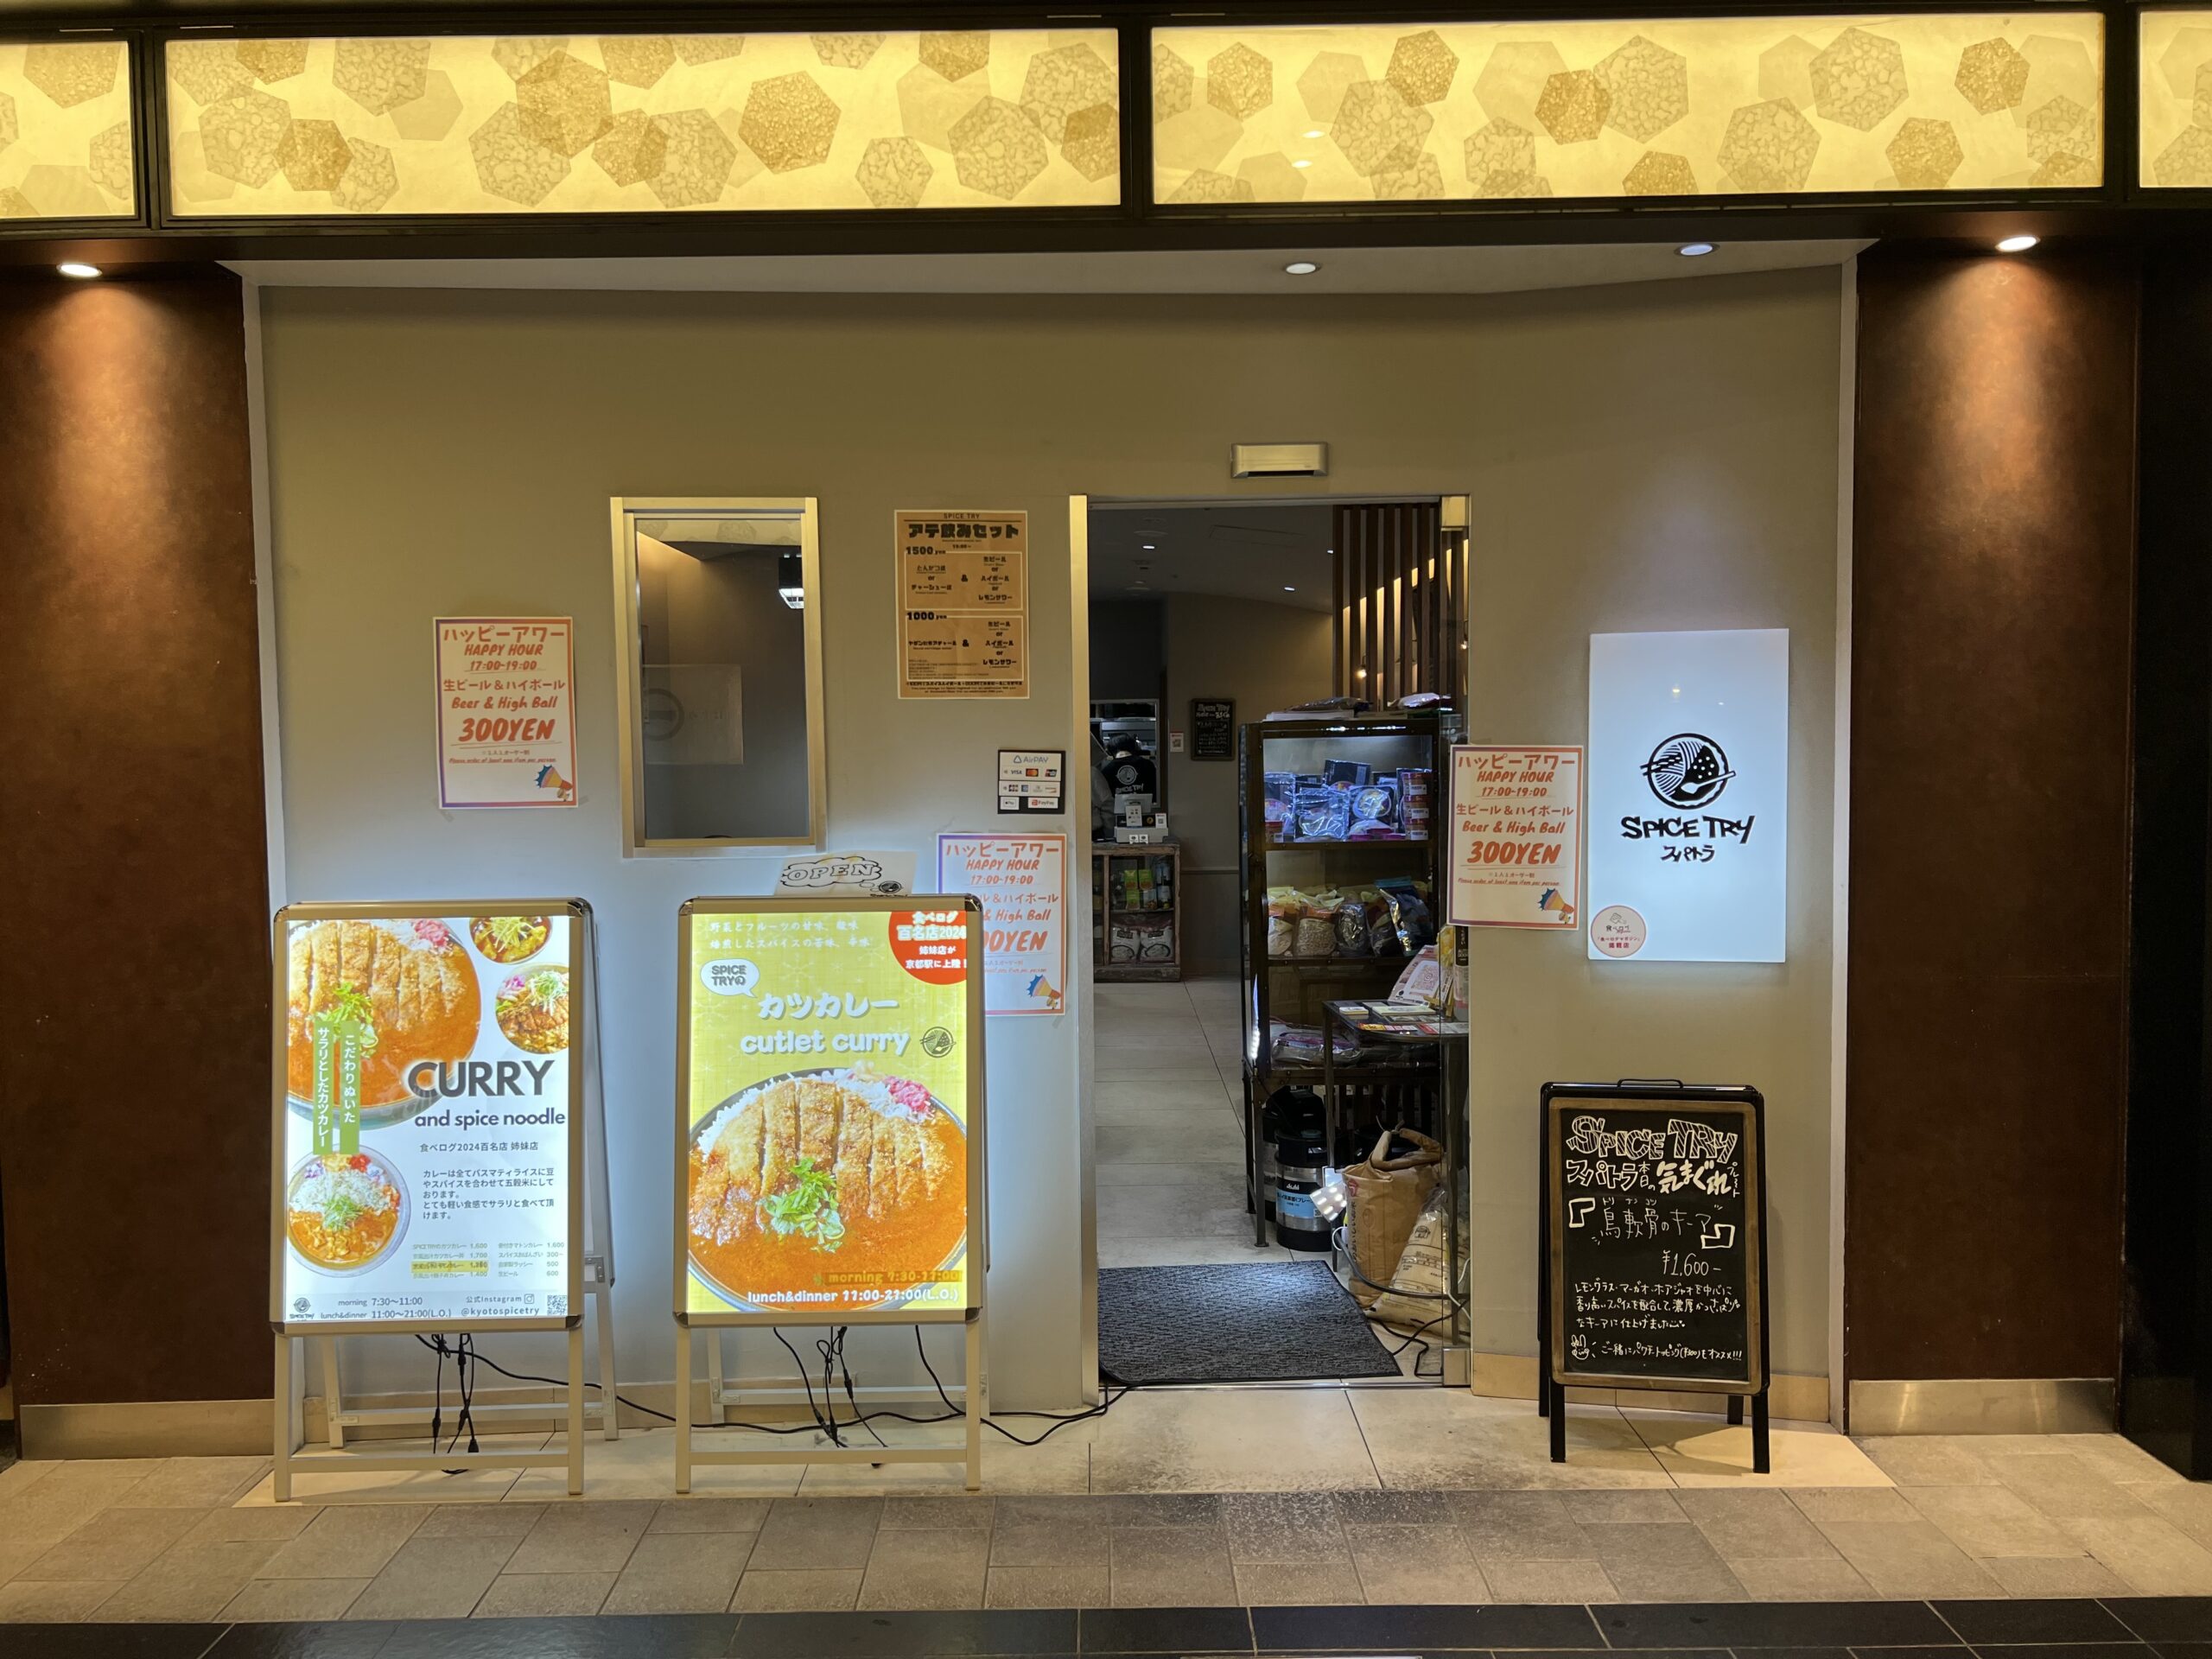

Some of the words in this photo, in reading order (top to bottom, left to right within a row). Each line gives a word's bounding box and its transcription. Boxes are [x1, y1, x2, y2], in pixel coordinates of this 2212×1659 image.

[908, 523, 1019, 539] アテ飲みセット
[906, 546, 933, 556] 1500
[961, 574, 969, 582] &
[906, 611, 935, 620] 1000
[443, 625, 564, 644] ハッピーアワー
[464, 644, 505, 656] HAPPY
[508, 644, 543, 656] HOUR
[962, 639, 969, 647] &
[451, 696, 480, 709] Beer
[483, 697, 493, 709] &
[498, 696, 528, 712] High
[531, 696, 558, 709] Ball
[458, 717, 556, 742] 300YEN
[1458, 753, 1575, 771] ハッピーアワー
[1477, 771, 1516, 783] HAPPY
[1518, 771, 1554, 783] HOUR
[1462, 821, 1490, 833] Beer
[1492, 821, 1503, 833] &
[1506, 821, 1535, 836] High
[1539, 821, 1566, 834] Ball
[1621, 815, 1701, 839] SPICE
[1702, 815, 1756, 845] TRY
[946, 842, 1059, 859] ハッピーアワー
[1466, 841, 1561, 865] 300YEN
[787, 864, 874, 881] OPEN
[965, 859, 1004, 871] HAPPY
[1006, 859, 1040, 871] HOUR
[995, 909, 1023, 925] High
[1027, 909, 1052, 921] Ball
[896, 925, 967, 941] 百名店2024
[983, 929, 1049, 952] 0YEN
[918, 945, 957, 956] 姉妹店が
[711, 965, 747, 976] SPICE
[758, 992, 899, 1020] カツカレー
[740, 1029, 826, 1054] cutlet
[831, 1032, 910, 1057] curry
[344, 1034, 357, 1123] こだわりぬいた
[407, 1059, 555, 1098] CURRY
[317, 1027, 330, 1147] サラリとしたカツカレー
[414, 1110, 451, 1128] and
[454, 1109, 499, 1131] spice
[503, 1108, 566, 1126] noodle
[419, 1141, 508, 1153] 食べログ2024百名店
[511, 1141, 539, 1151] 姉妹店
[1566, 1116, 1666, 1160] SPICE
[1667, 1118, 1738, 1164] TRY
[423, 1167, 555, 1179] カレーは全てバスマティライスに豆
[423, 1178, 554, 1189] やスパイスを合わせて五穀米にして
[423, 1190, 460, 1199] おります。
[423, 1198, 555, 1210] とても軽い食感でサラリと食べて頂
[423, 1211, 452, 1220] けます。
[829, 1271, 883, 1286] morning
[887, 1270, 958, 1282] 7:30-11:00
[338, 1299, 368, 1307] morning
[466, 1295, 522, 1304] 公式Instagram
[747, 1290, 838, 1303] lunch&dinner
[842, 1288, 958, 1302] 11:00-21:00(L.O.)
[320, 1311, 367, 1319] lunch&dinner
[461, 1306, 540, 1318] @kyotospicetry
